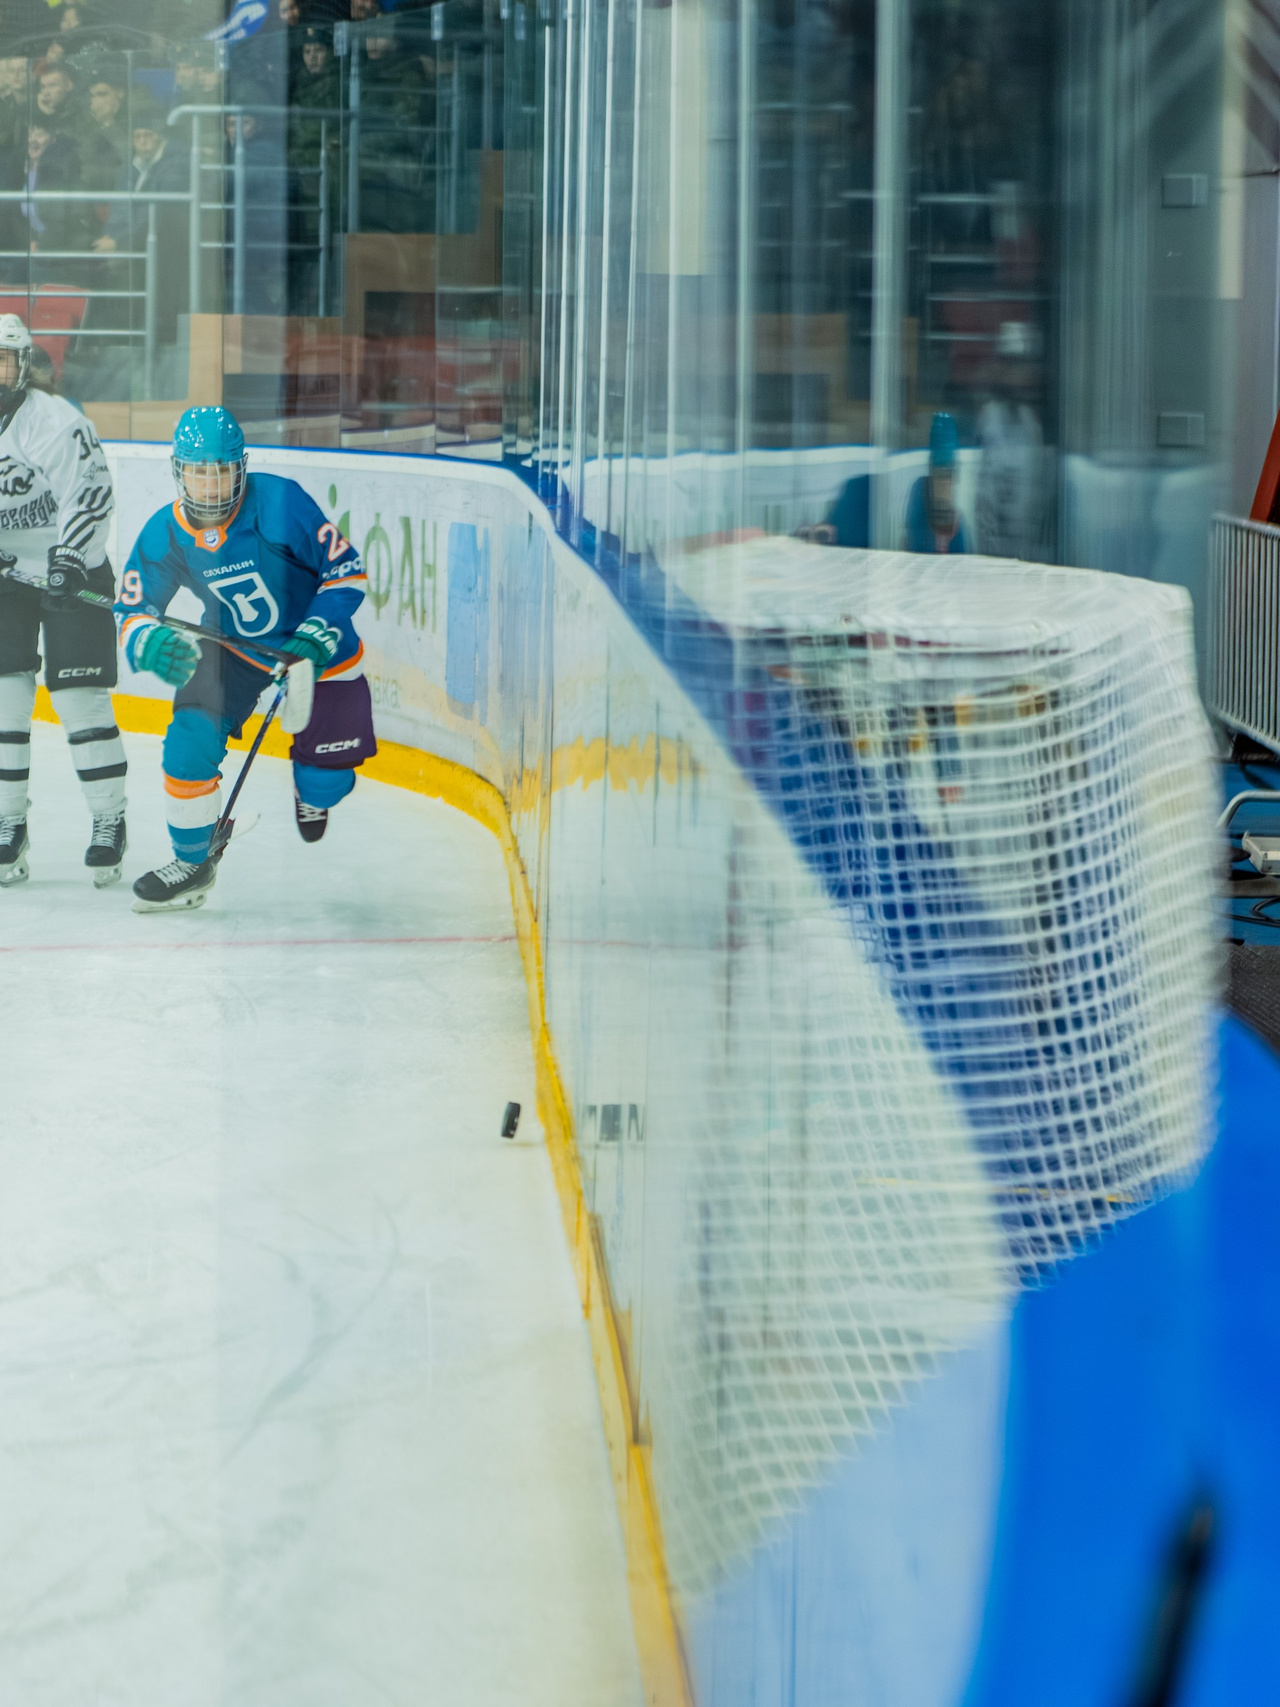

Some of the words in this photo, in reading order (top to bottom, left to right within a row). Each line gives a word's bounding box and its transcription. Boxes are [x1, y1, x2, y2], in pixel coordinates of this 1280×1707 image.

[72, 424, 104, 461] 34
[57, 666, 103, 679] CCM
[314, 737, 361, 754] CCM
